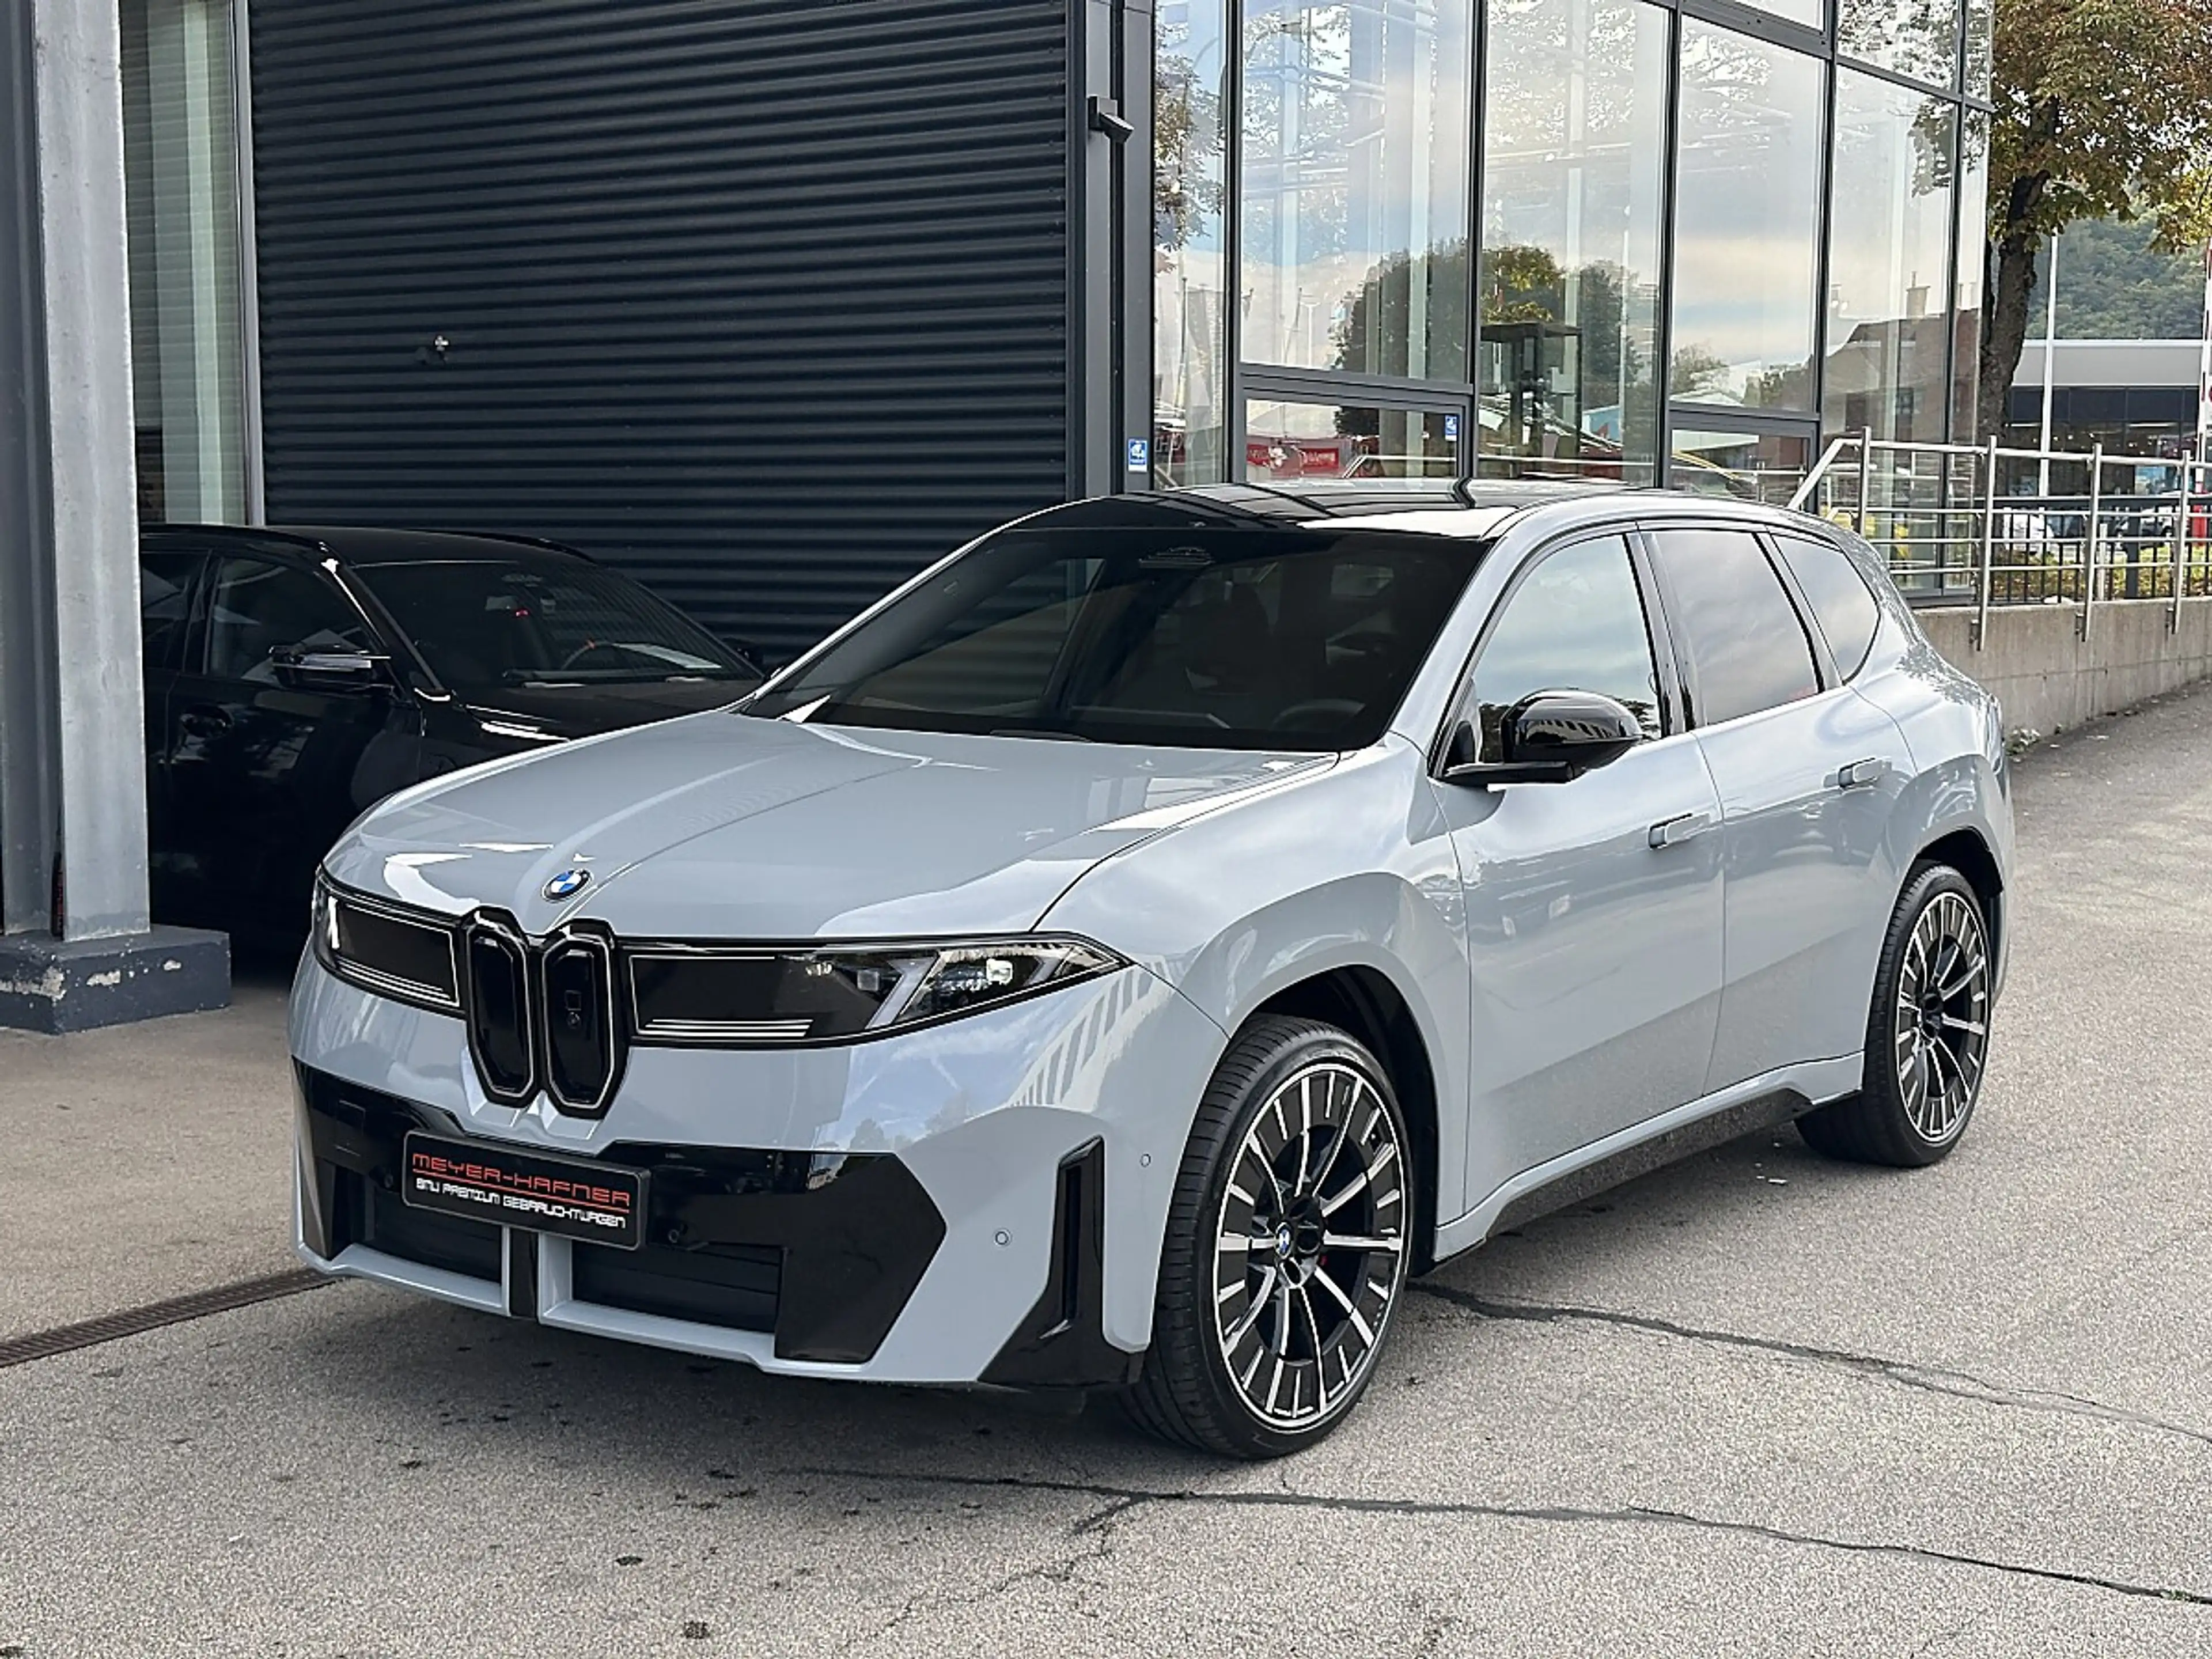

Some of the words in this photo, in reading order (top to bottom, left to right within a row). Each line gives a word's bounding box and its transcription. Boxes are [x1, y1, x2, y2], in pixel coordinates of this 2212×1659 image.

[412, 1153, 630, 1206] MEYER-HAFNER
[416, 1177, 440, 1194] BMW
[442, 1183, 501, 1205] PREMIUM
[503, 1195, 626, 1229] GEBRAUCHTWAGEN
